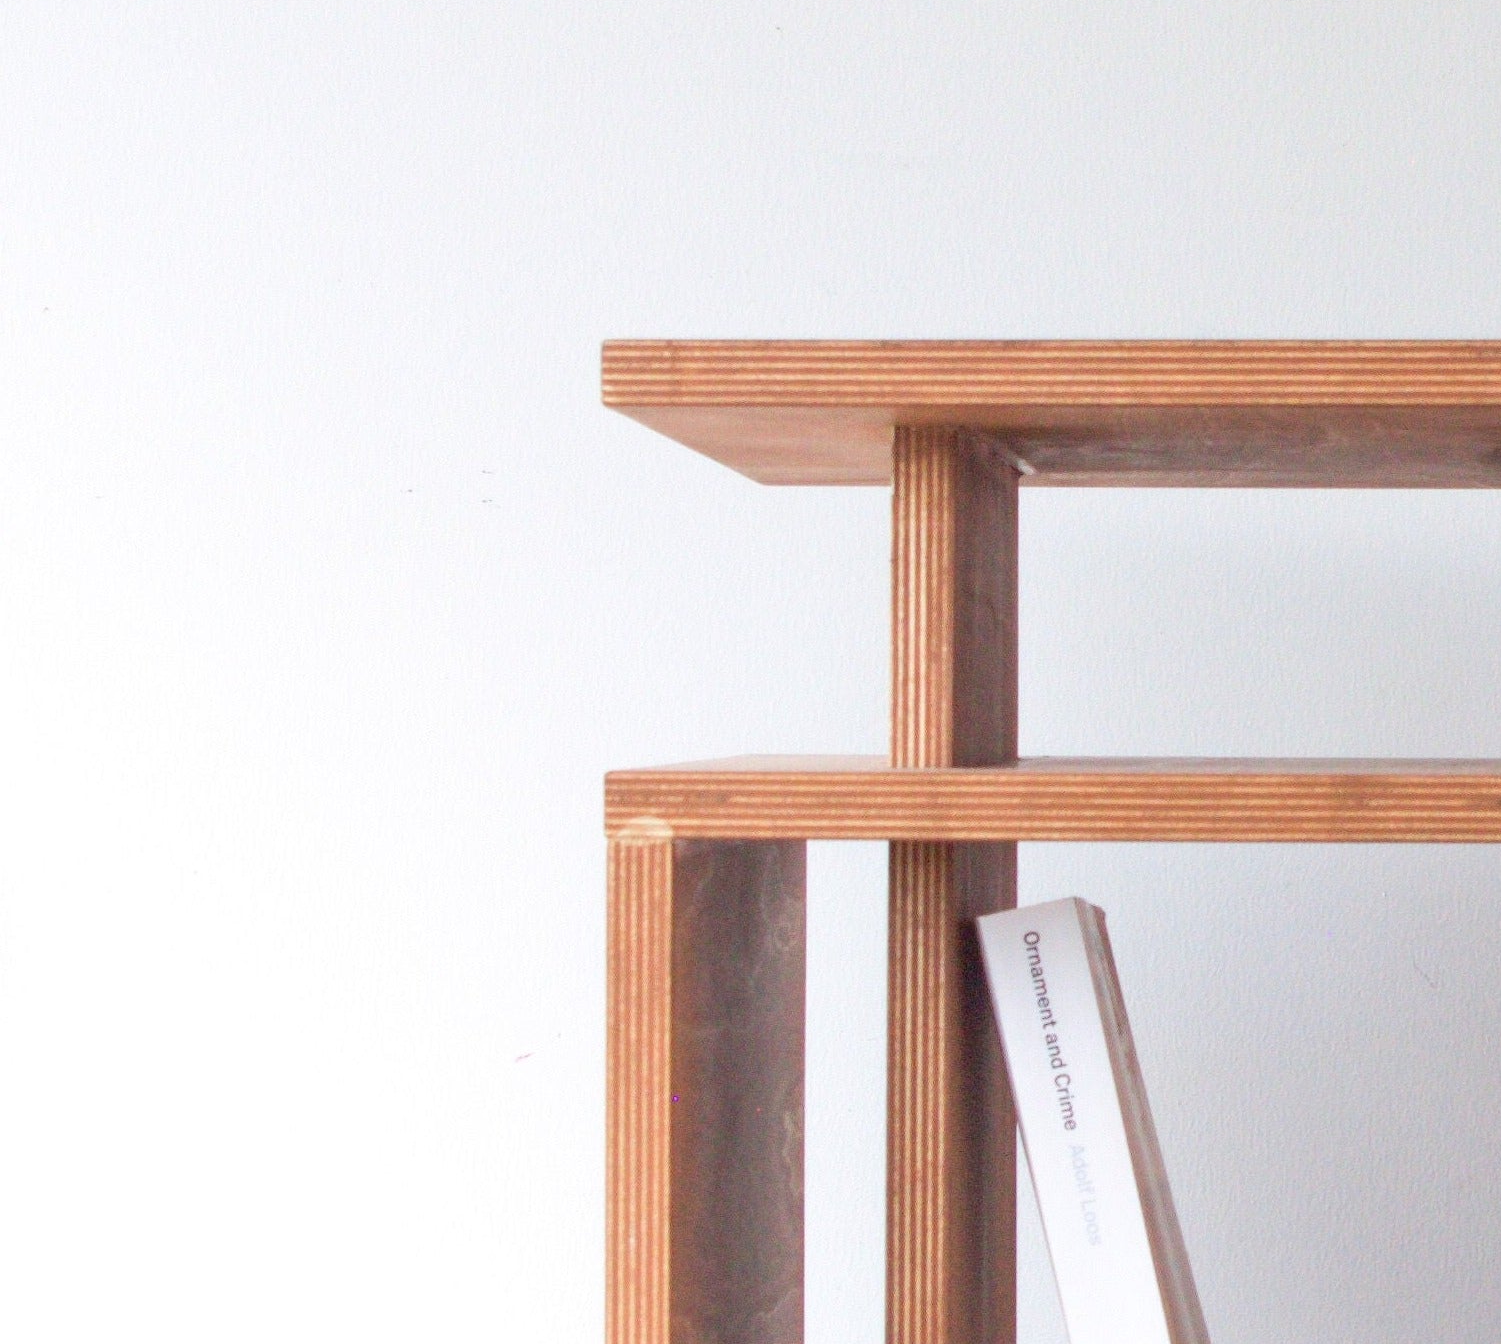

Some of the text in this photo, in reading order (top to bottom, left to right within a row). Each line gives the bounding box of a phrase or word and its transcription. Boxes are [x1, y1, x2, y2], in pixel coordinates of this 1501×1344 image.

[1023, 930, 1101, 1247] Ornament and Crime Adolf Loos
